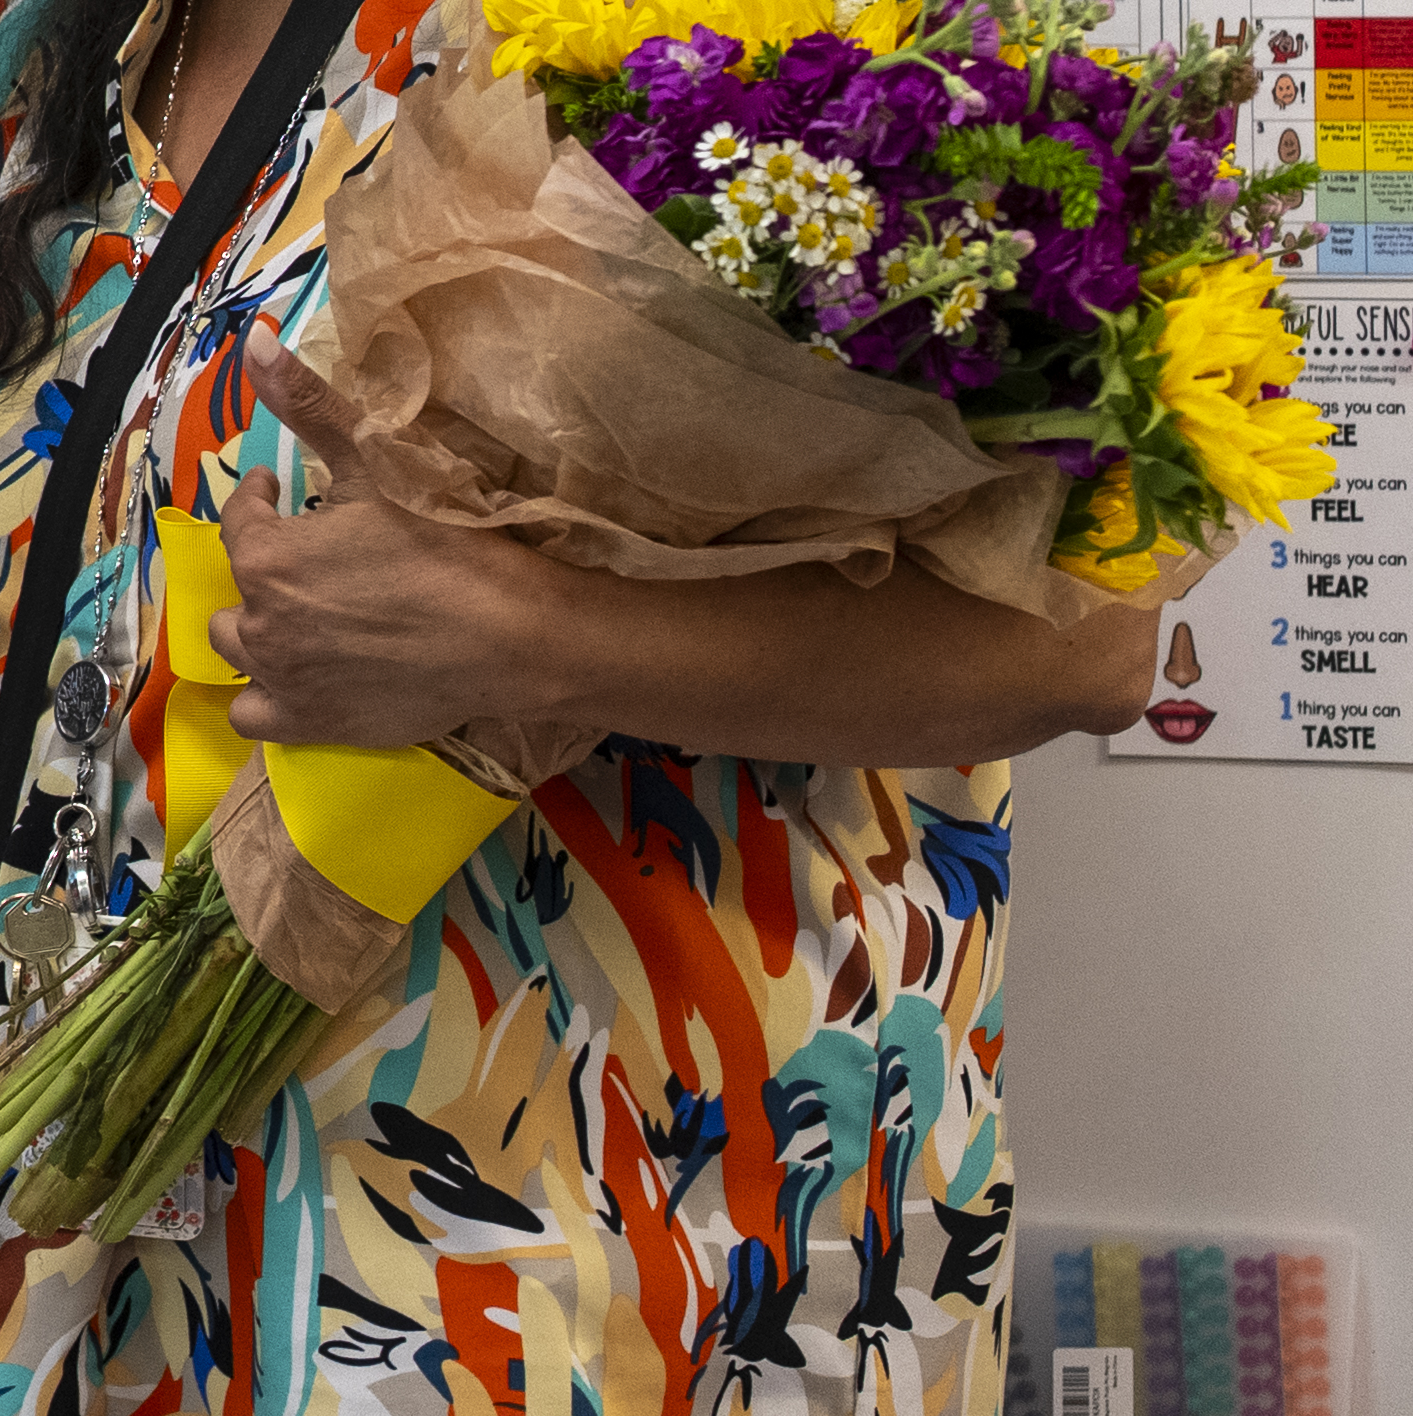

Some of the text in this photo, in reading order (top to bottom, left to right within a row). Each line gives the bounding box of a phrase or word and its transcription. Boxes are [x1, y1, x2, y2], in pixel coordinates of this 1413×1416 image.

[1328, 72, 1352, 81] Feeling
[1328, 82, 1351, 92] Pretty
[1326, 93, 1354, 101] Nervous
[1320, 123, 1362, 133] Feeling Kind
[1332, 134, 1360, 142] Worried
[1327, 186, 1356, 194] Nervous
[1330, 227, 1354, 235] Feeling
[1331, 236, 1353, 245] Super
[1331, 246, 1353, 256] Happy
[1357, 305, 1413, 342] SENS
[1308, 364, 1338, 373] through
[1345, 402, 1372, 417] you
[1377, 402, 1405, 415] can
[1346, 478, 1373, 493] you
[1378, 478, 1407, 491] can
[1312, 499, 1363, 522] FEEL
[1271, 540, 1407, 569] 3 things you can
[1307, 574, 1368, 598] HEAR
[1271, 617, 1407, 646] 2 things you can
[1301, 650, 1376, 673] SMELL
[1280, 692, 1401, 720] 1 thing you can
[1302, 725, 1376, 749] TASTE
